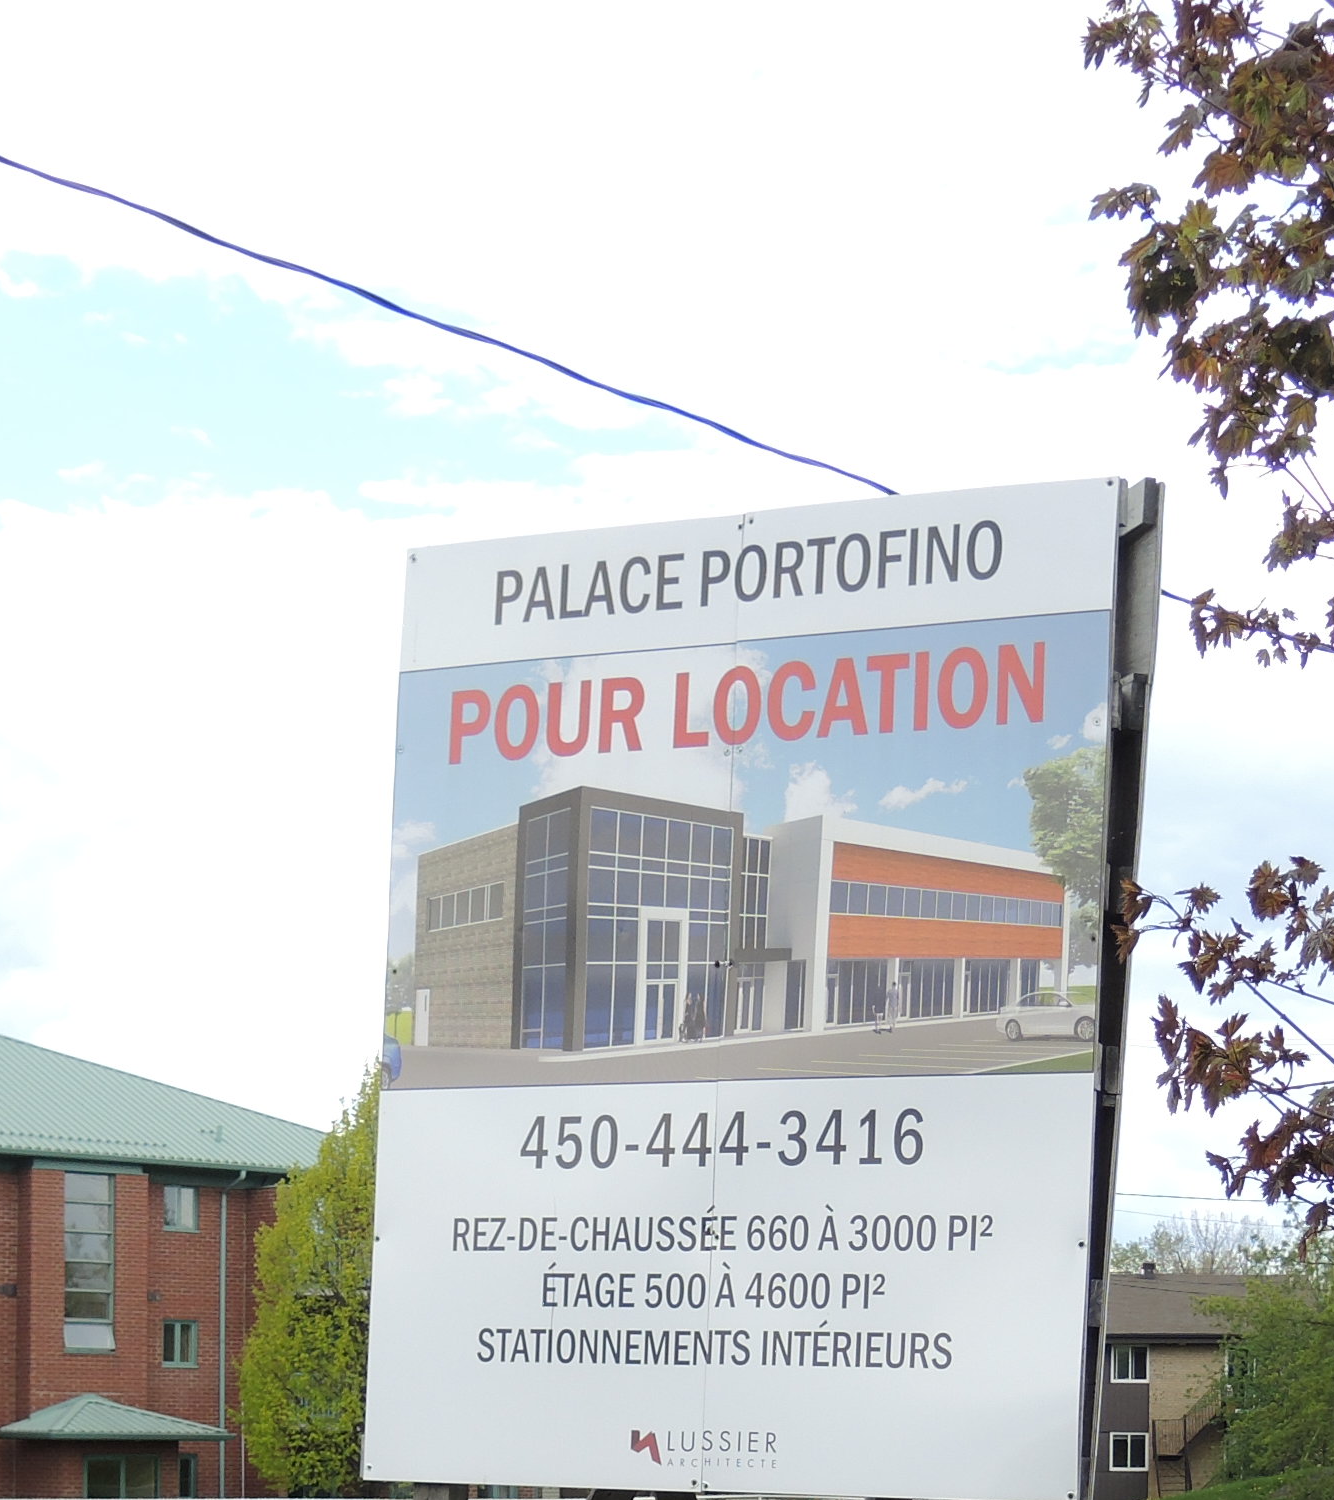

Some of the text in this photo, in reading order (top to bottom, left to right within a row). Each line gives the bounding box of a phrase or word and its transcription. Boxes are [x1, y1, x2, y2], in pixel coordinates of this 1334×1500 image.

[495, 519, 1004, 626] PALACE PORTOFINO
[449, 641, 1046, 764] POUR LOCATION
[520, 1108, 924, 1170] 450-444-3416
[452, 1204, 738, 1252] REZ-DE-CHAUSSÉE
[747, 1214, 810, 1252] 660
[817, 1204, 840, 1252] À
[848, 1214, 938, 1252] 3000
[542, 1262, 637, 1309] ÉTAGE
[644, 1273, 707, 1310] 500
[714, 1261, 736, 1309] À
[744, 1272, 832, 1310] 4600
[477, 1320, 953, 1371] STATIONNEMENTS INTÉRIEURS
[666, 1429, 778, 1454] LUSSIER
[666, 1457, 778, 1470] ARCHITECTE
